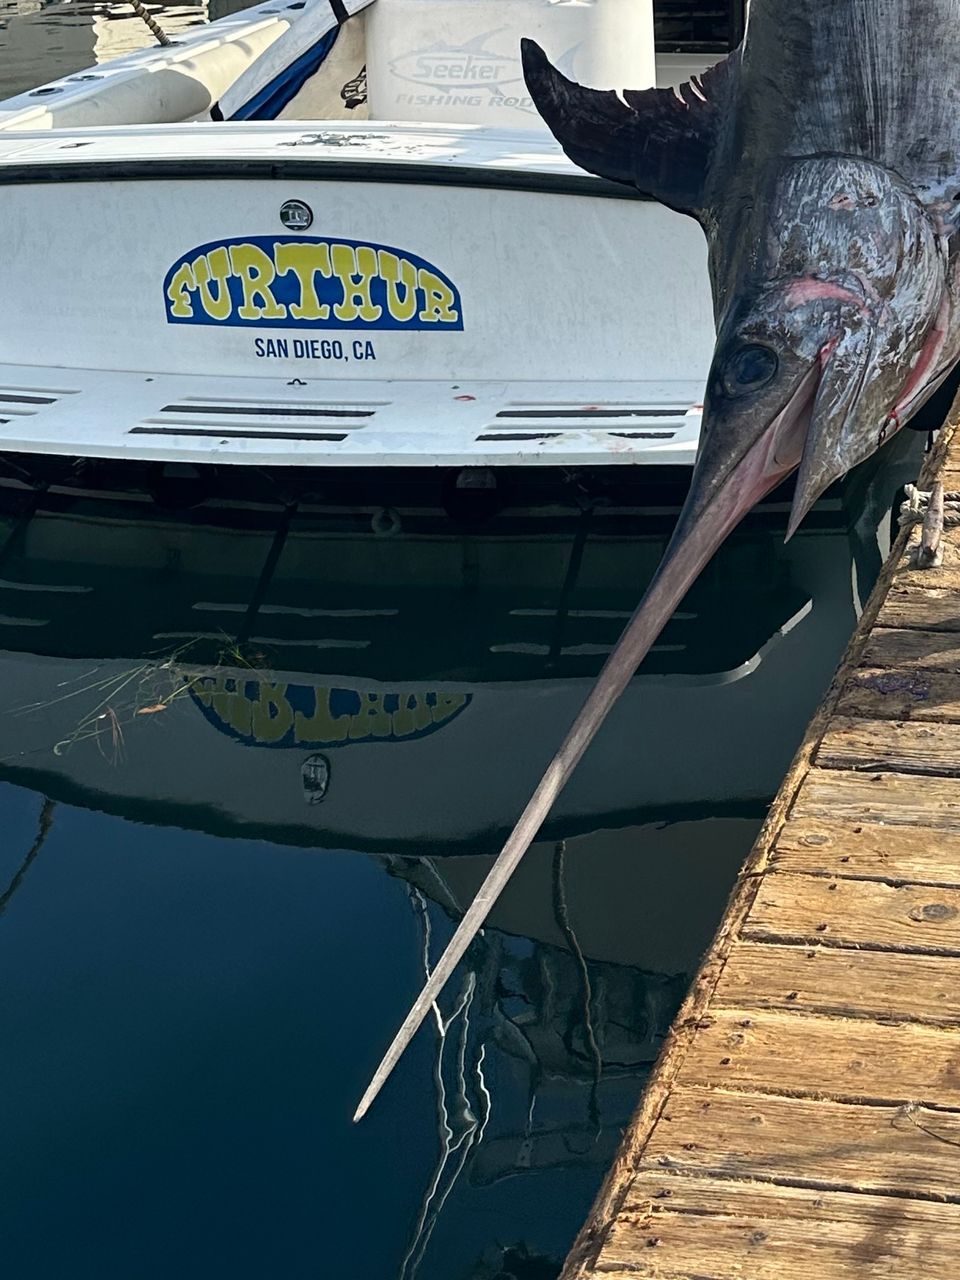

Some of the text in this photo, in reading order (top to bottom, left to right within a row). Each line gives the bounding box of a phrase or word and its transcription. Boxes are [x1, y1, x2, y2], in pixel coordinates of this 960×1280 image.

[413, 56, 507, 80] Seeker
[395, 94, 534, 107] FISHING ROD
[166, 242, 458, 323] FURTHUR
[255, 338, 376, 362] SAN DIEGO, CA
